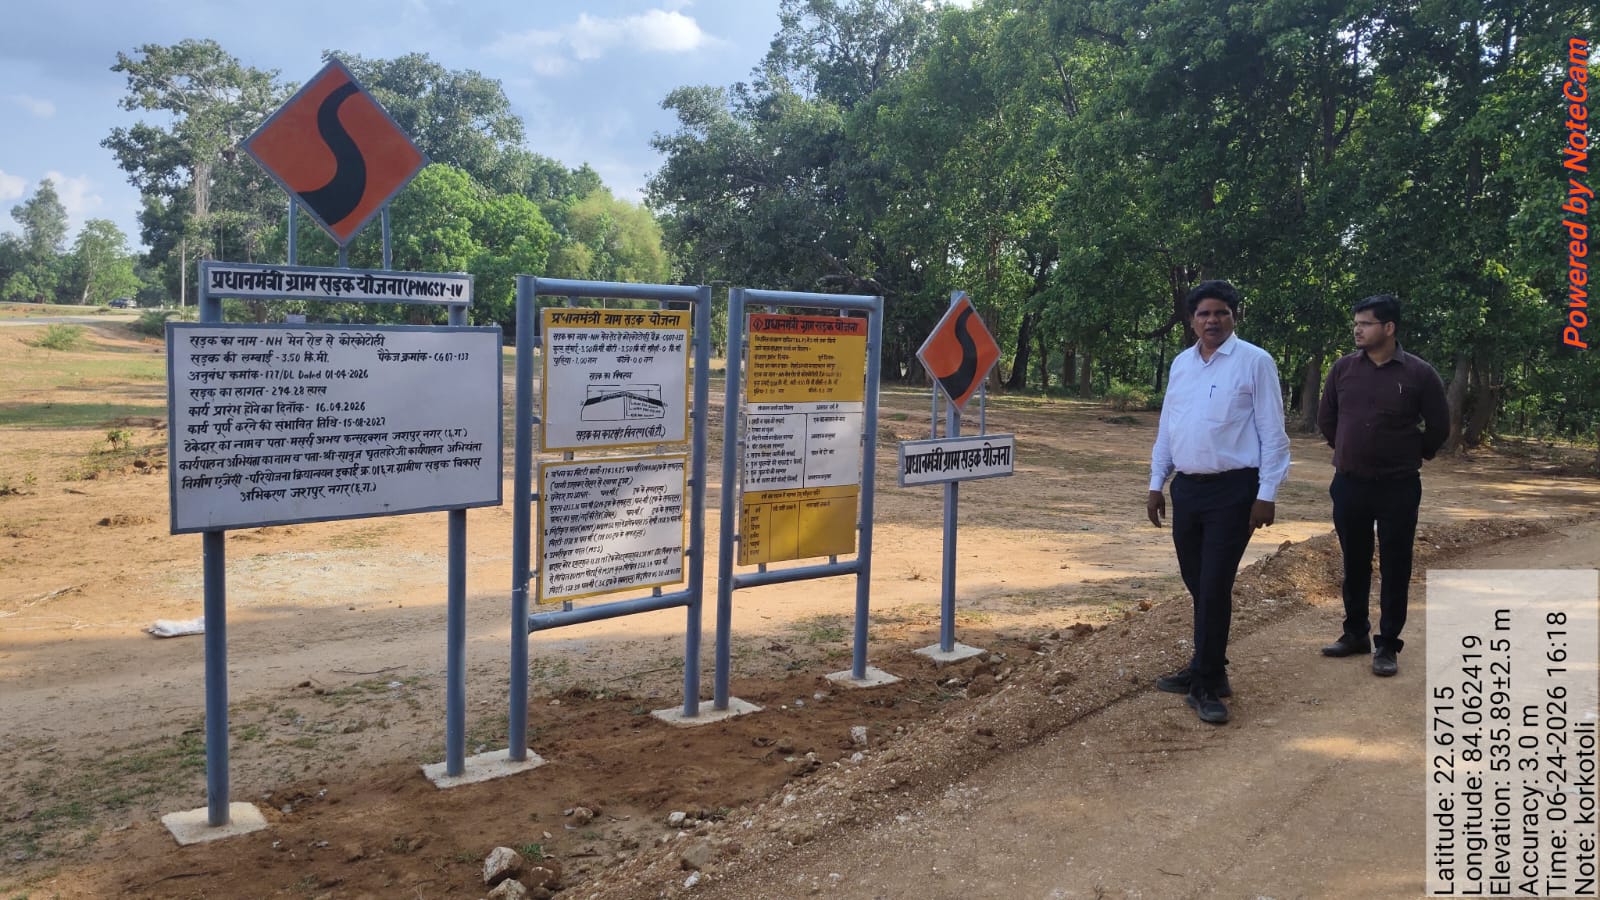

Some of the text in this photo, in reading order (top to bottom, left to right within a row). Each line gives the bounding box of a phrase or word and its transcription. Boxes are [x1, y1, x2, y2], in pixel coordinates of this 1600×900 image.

[211, 269, 284, 291] प्रधानमंत्री
[286, 273, 318, 291] ग्राम
[319, 275, 355, 296] सड़क
[356, 274, 404, 295] योजना
[648, 311, 680, 326] योजना
[189, 335, 218, 349] सड़क
[220, 336, 236, 346] का
[237, 336, 258, 346] नाम
[266, 336, 282, 346] NH
[286, 332, 304, 346] मेन
[306, 331, 323, 349] रोड
[325, 333, 335, 349] से
[190, 353, 220, 366] सड़क
[223, 351, 238, 363] की
[187, 367, 227, 384] अनुबंध
[188, 402, 210, 416] कार्य
[188, 420, 209, 435] कार्य
[213, 418, 234, 437] पूर्ण
[235, 418, 257, 434] करने
[259, 419, 272, 431] की
[218, 440, 232, 451] का
[423, 430, 443, 441] नगर
[179, 456, 226, 471] कार्यपालन
[274, 455, 292, 464] नाम
[424, 459, 451, 473] सड़क
[904, 442, 1011, 475] प्रधानमंत्री ग्राम सड़क योजना
[240, 487, 287, 502] अभिकरण
[290, 485, 326, 500] जशपुर
